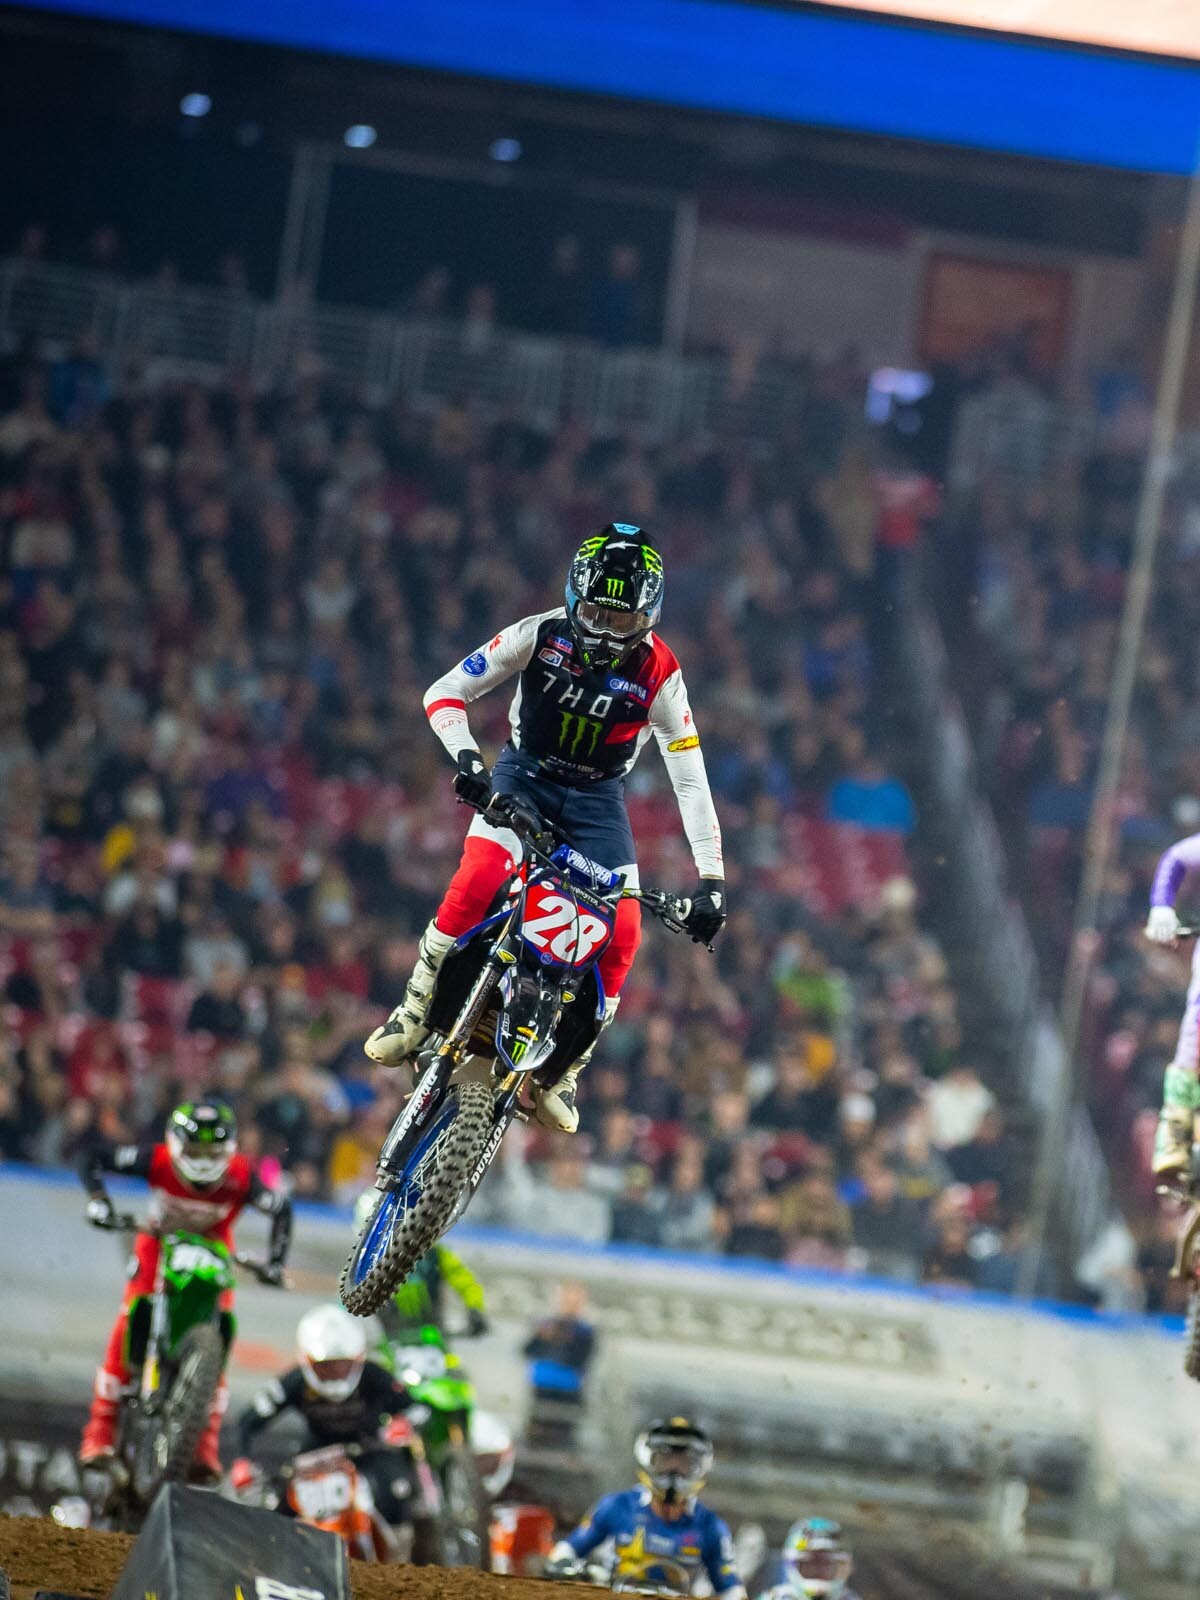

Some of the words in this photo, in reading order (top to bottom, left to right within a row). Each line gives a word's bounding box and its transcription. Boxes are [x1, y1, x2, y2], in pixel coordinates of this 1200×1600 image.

[594, 596, 631, 609] MONSTER
[521, 896, 608, 963] 28
[471, 1115, 507, 1187] DUNLOP
